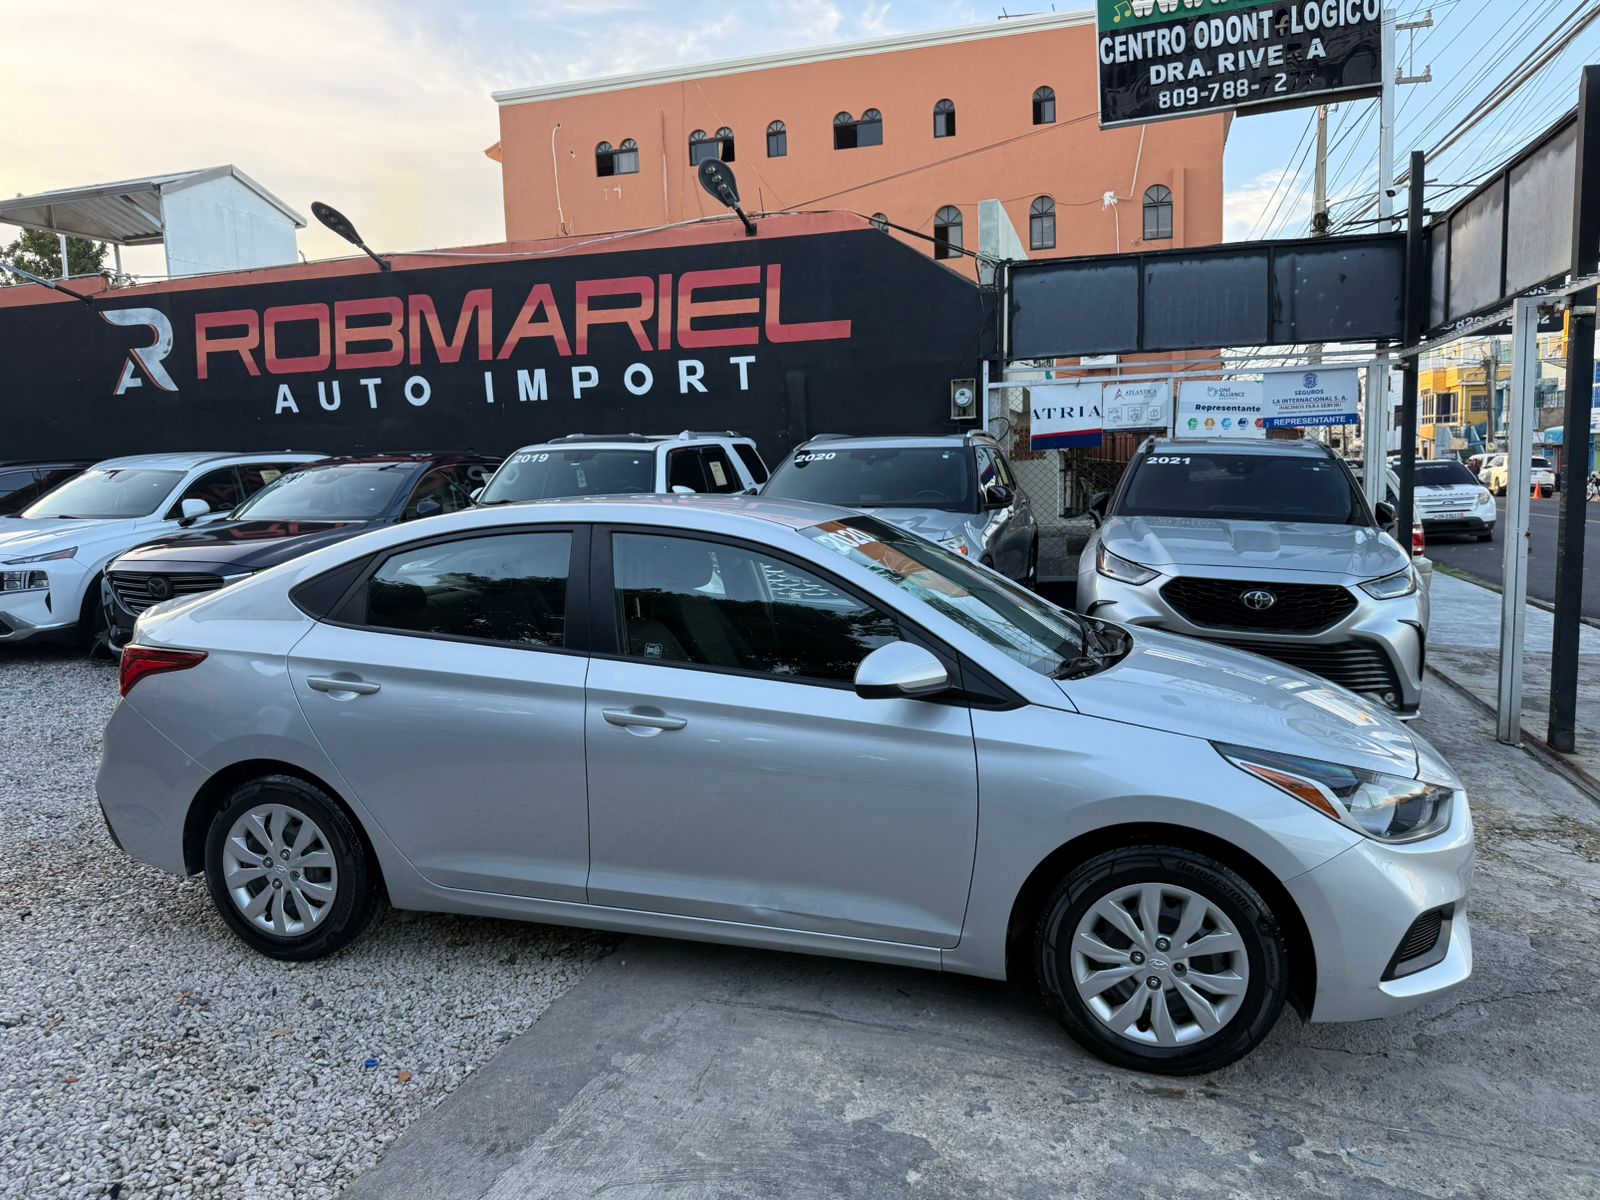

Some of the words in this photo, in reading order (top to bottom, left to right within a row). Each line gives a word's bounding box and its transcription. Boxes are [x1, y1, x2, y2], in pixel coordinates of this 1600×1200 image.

[1099, 25, 1186, 65] CENTRO
[1193, 0, 1381, 50] ODONTLOGICO
[193, 263, 852, 380] ROBMARIEL
[274, 375, 432, 415] AUTO
[484, 355, 757, 403] IMPORT
[1294, 388, 1324, 396] SEGUROS
[1281, 395, 1333, 404] INTERNACIONAL
[1195, 403, 1262, 413] Representante
[1273, 415, 1346, 427] REPRESENTANTE
[510, 453, 550, 464] 2019
[794, 452, 837, 463] 2020
[1146, 456, 1191, 465] 2021
[819, 527, 877, 552] 2020
[1175, 860, 1253, 913] BRIDGESTONE
